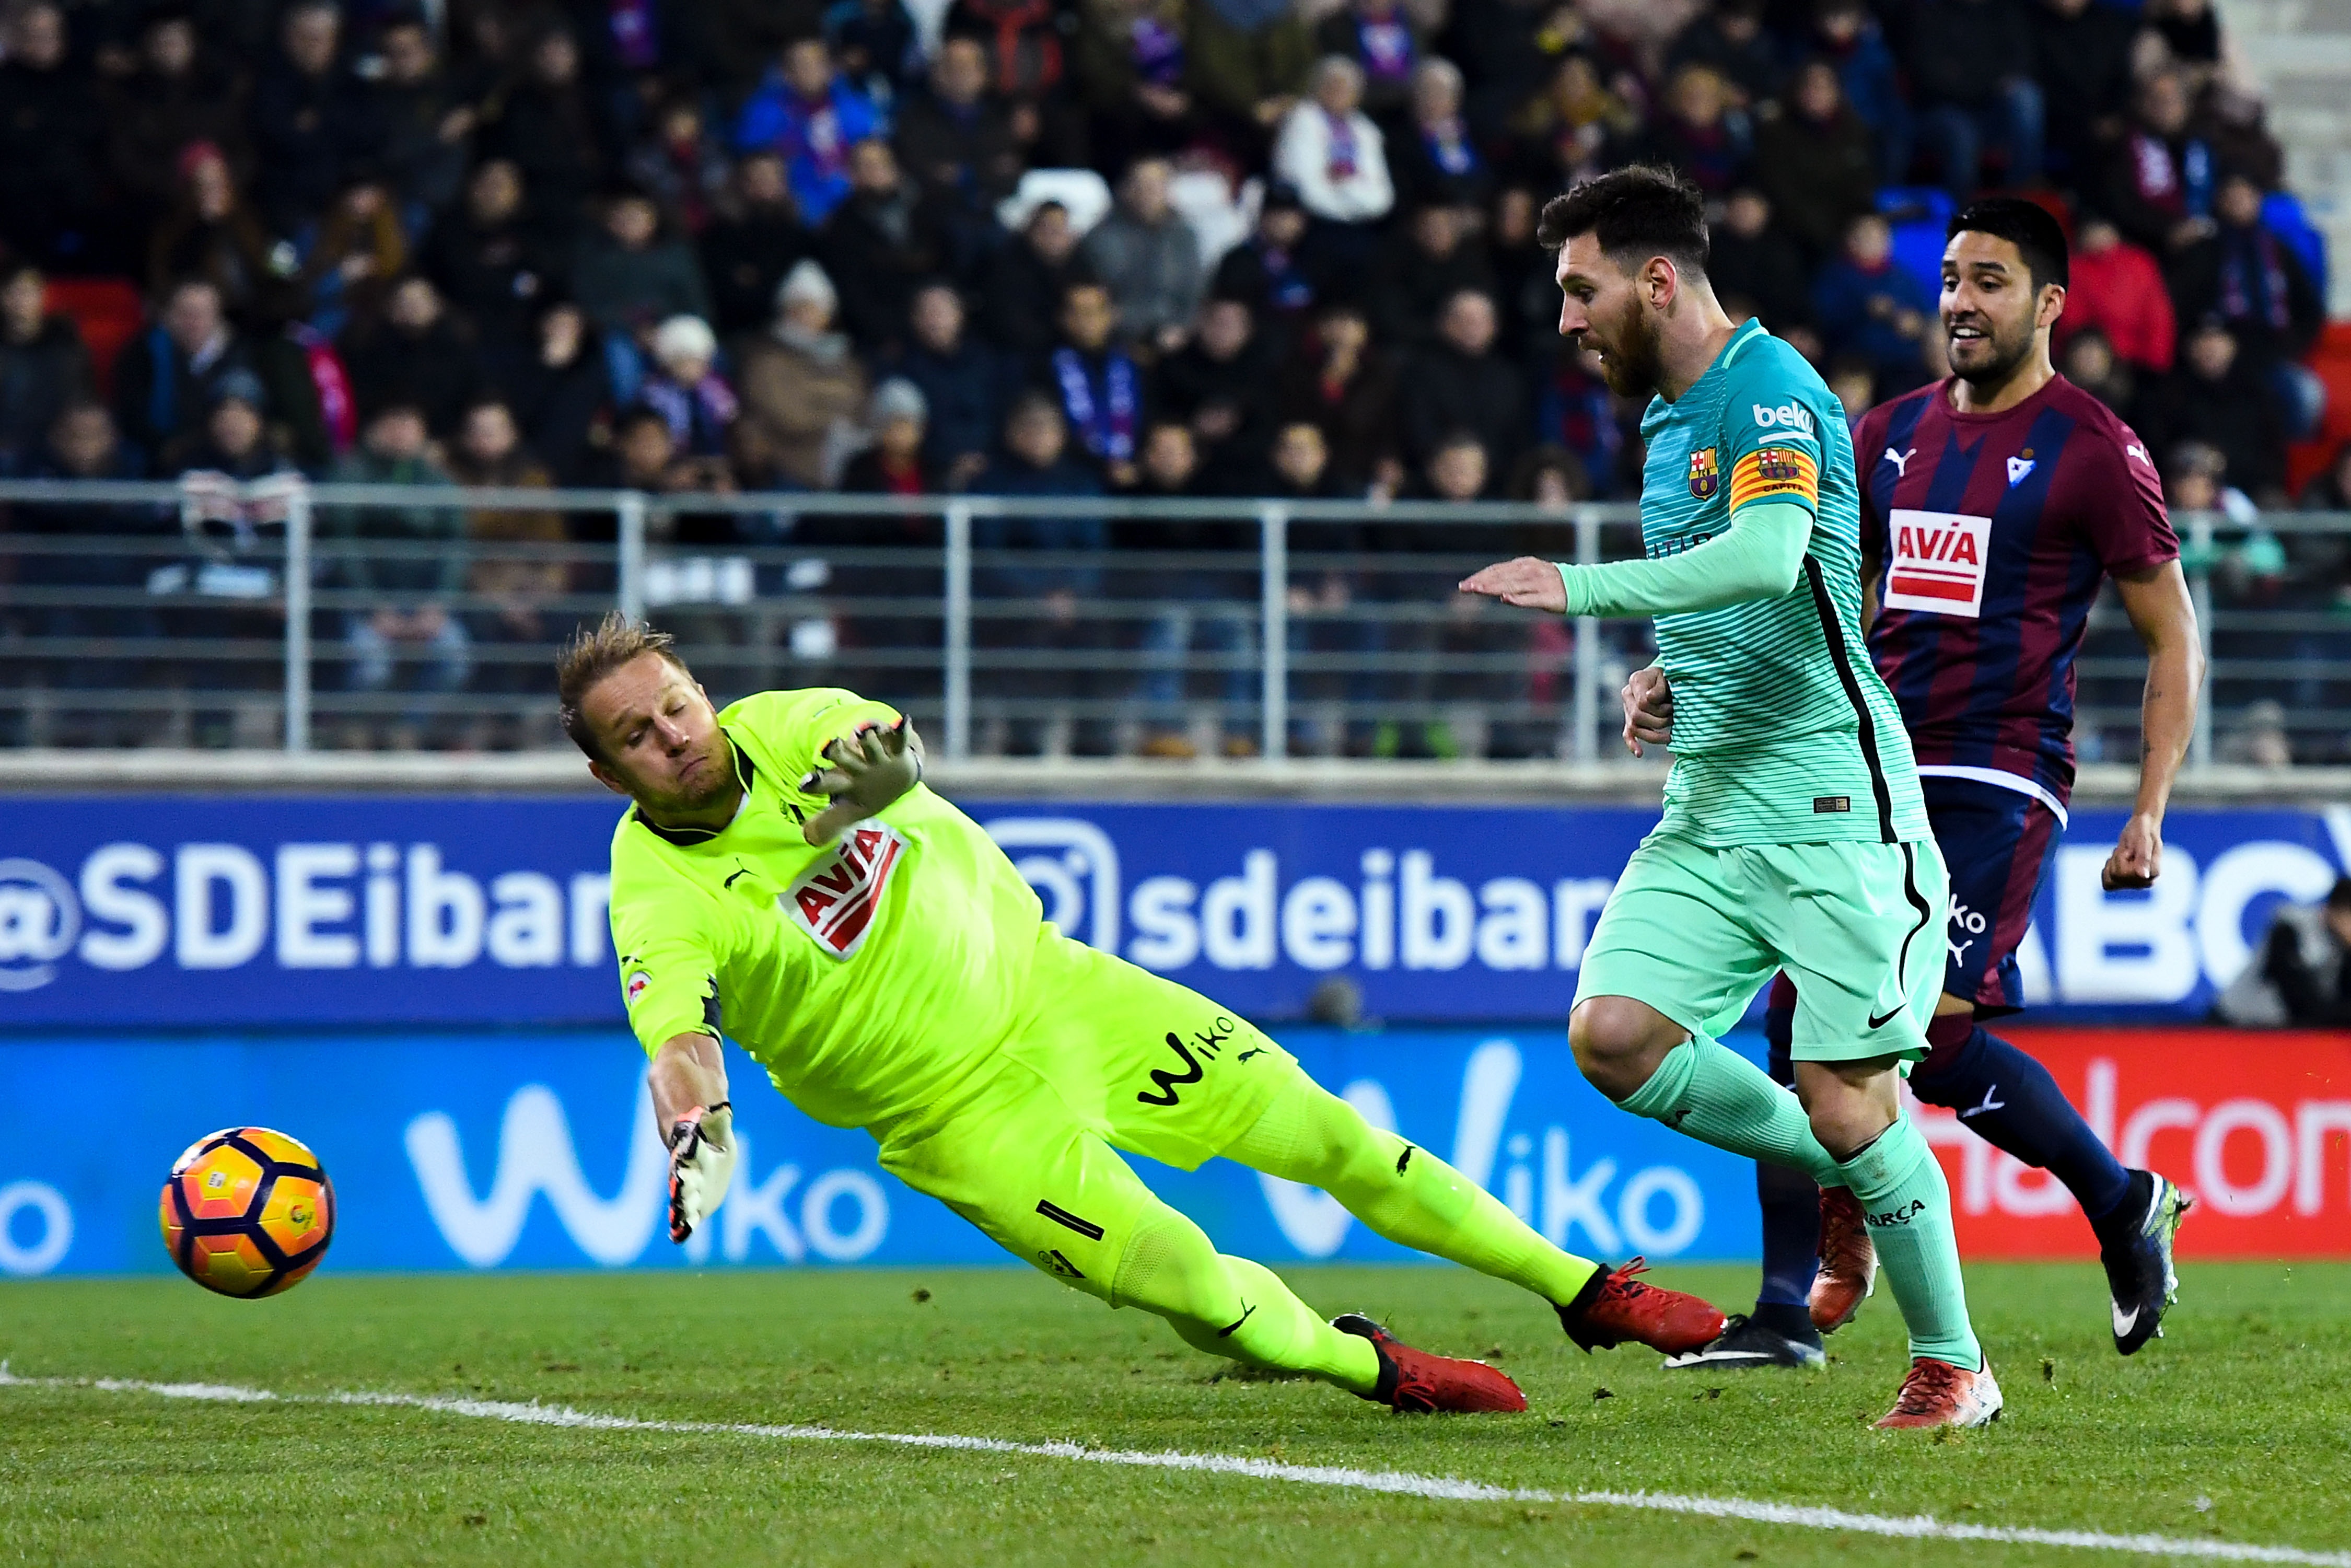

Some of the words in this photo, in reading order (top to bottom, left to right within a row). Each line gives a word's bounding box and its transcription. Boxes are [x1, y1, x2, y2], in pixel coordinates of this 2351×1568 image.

[1752, 401, 1814, 433] beko
[1127, 849, 1620, 971] sdeibar
[1137, 1016, 1234, 1107] Wiko
[403, 1061, 891, 1267] Wko
